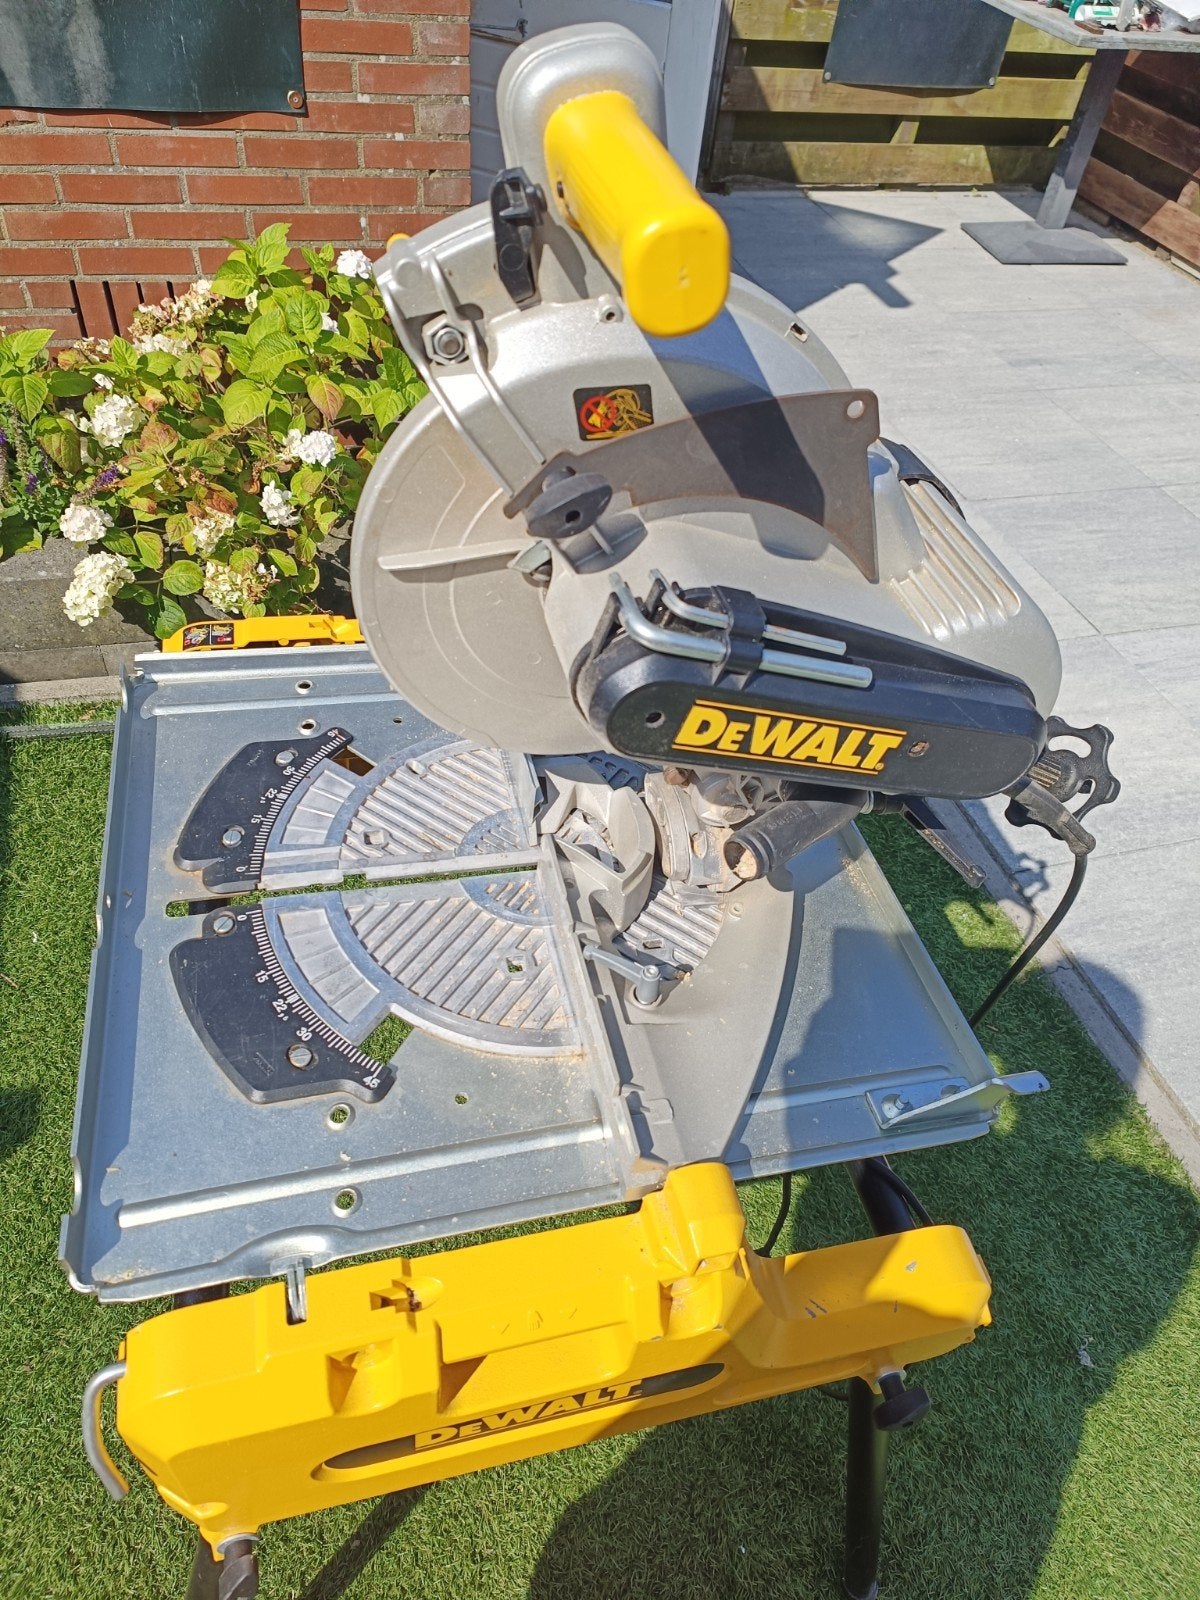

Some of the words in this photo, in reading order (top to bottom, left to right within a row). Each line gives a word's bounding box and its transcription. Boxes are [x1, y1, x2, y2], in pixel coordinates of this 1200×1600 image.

[282, 765, 296, 776] 30
[250, 814, 263, 824] 15
[236, 914, 248, 922] 0
[254, 969, 268, 983] 15
[295, 1026, 313, 1042] 30
[362, 1075, 381, 1089] 45
